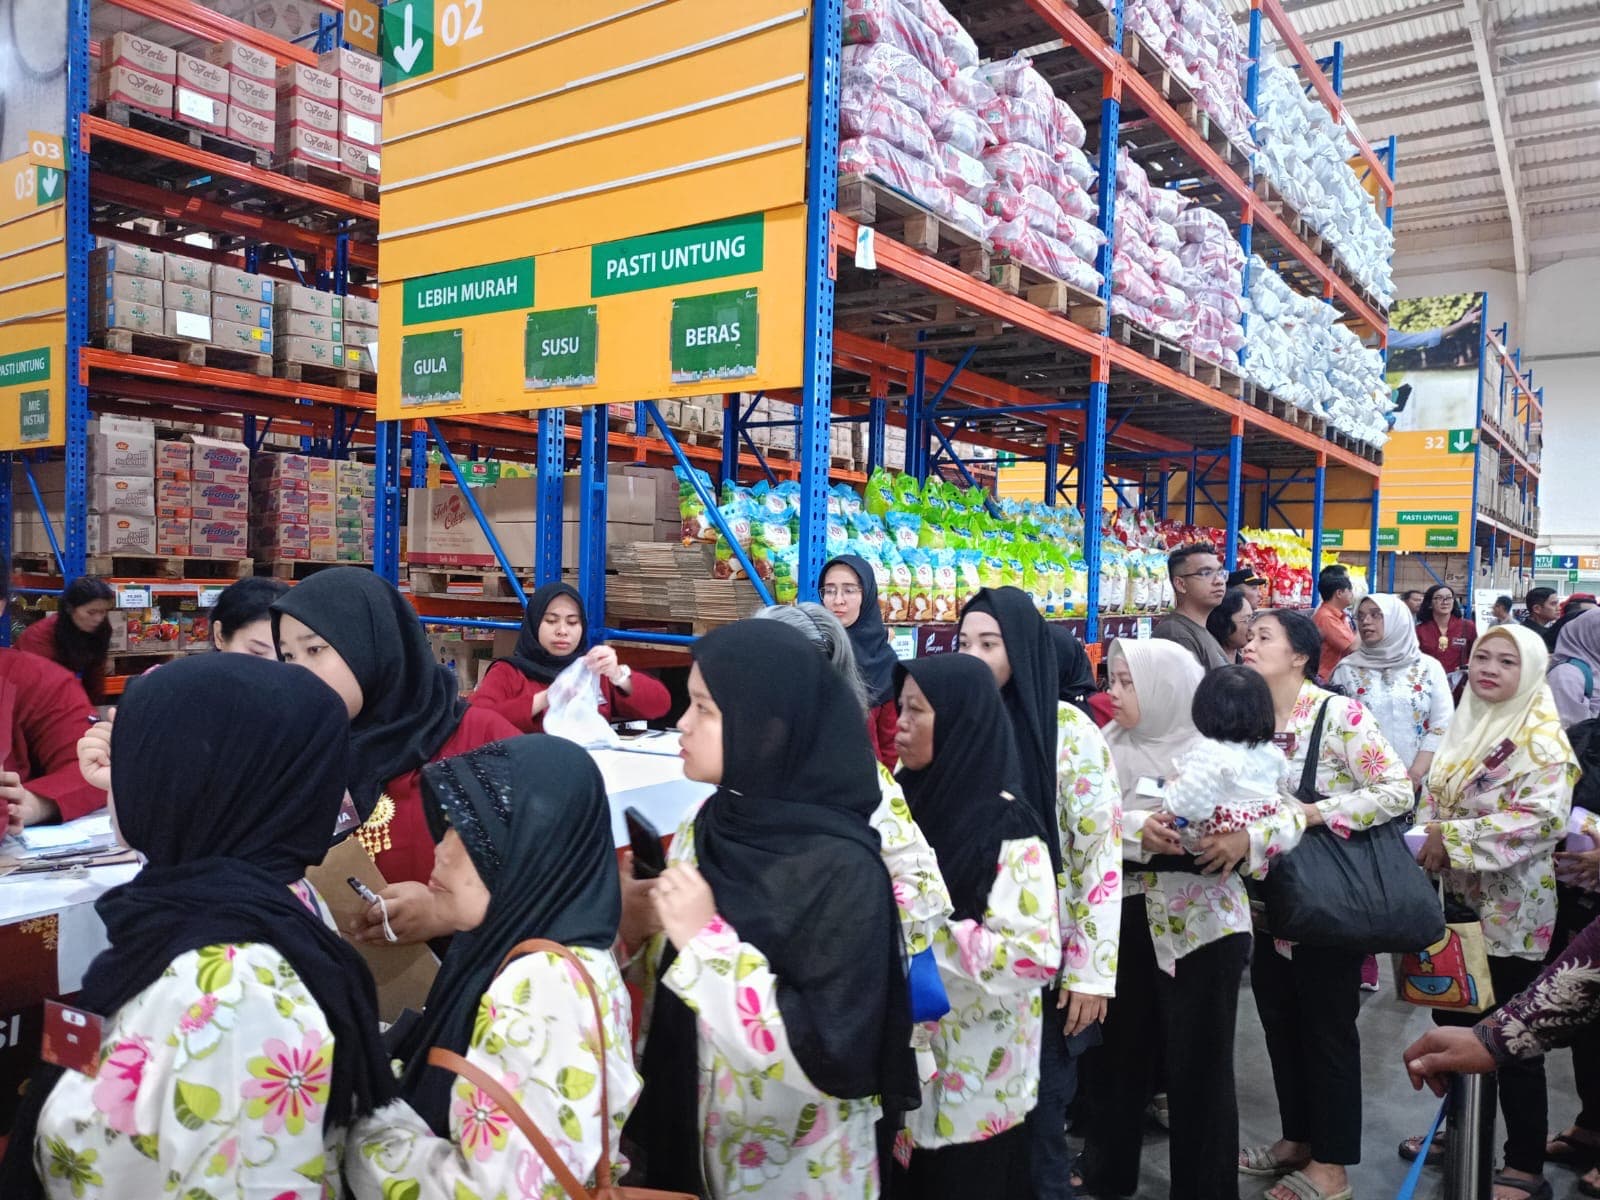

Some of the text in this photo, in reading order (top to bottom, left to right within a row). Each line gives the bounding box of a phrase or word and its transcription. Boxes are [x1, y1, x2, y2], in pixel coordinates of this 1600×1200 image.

[348, 8, 375, 39] 02
[441, 0, 484, 47] 02
[32, 141, 61, 159] 03
[15, 168, 34, 200] 03
[606, 235, 746, 281] PASTI UNTUNG
[417, 275, 518, 310] LEBIH MURAH
[685, 322, 741, 347] BERAS
[541, 336, 580, 357] SUSU
[16, 357, 45, 375] UNTUNG
[413, 356, 448, 376] GULA
[28, 400, 41, 411] MIE
[1424, 436, 1445, 450] 32
